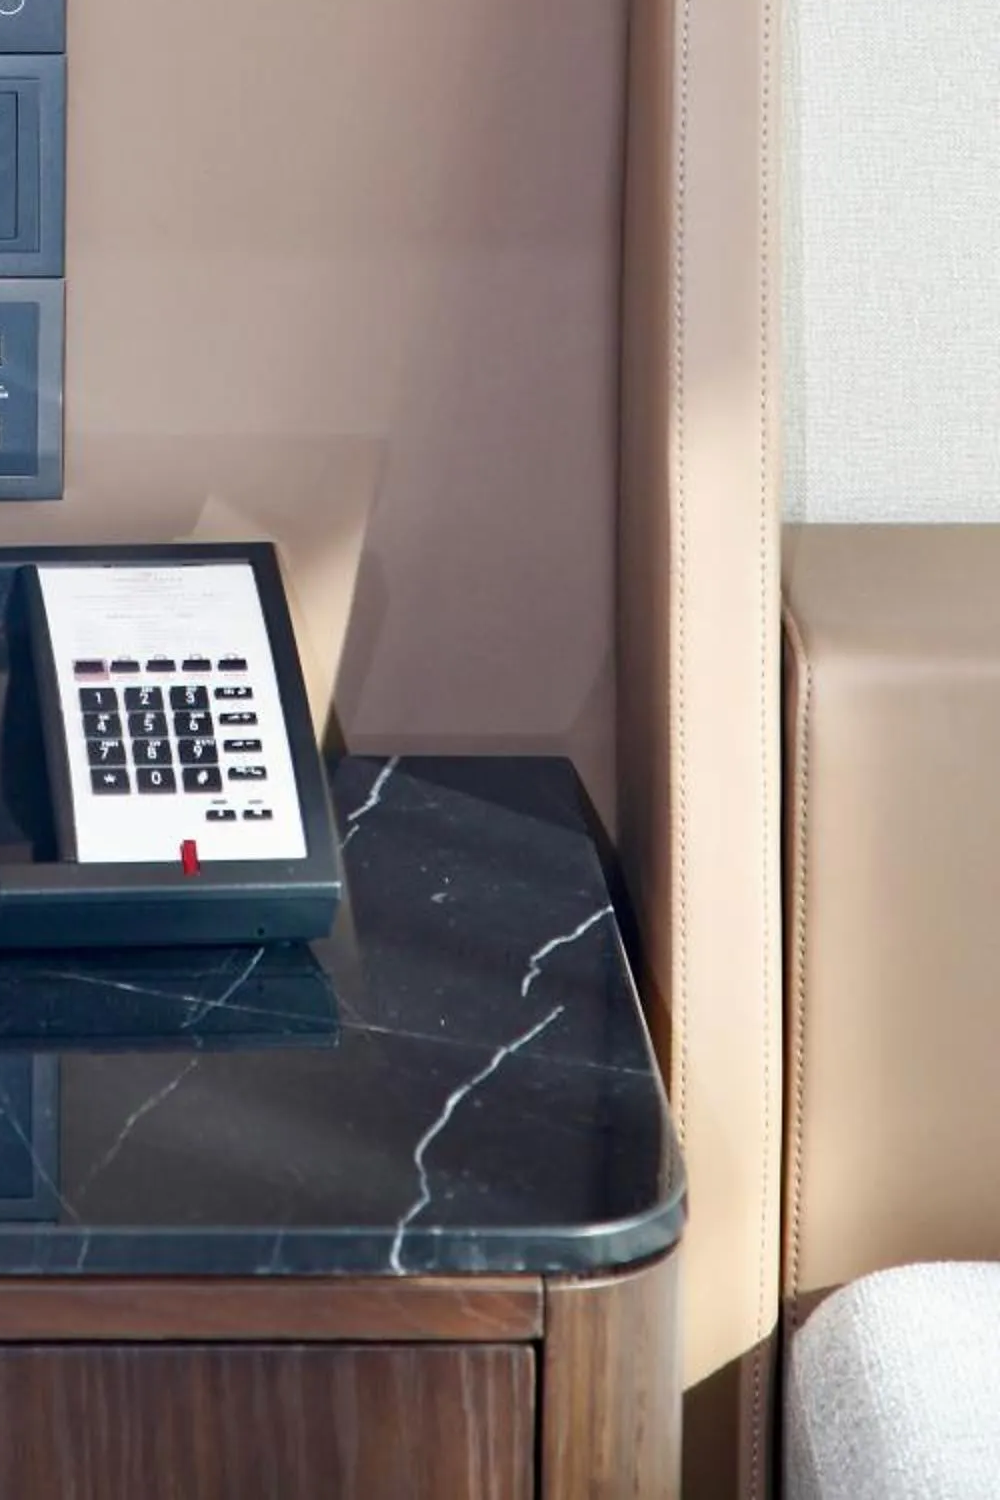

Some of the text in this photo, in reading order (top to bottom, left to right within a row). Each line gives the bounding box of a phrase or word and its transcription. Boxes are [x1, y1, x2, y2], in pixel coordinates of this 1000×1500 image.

[94, 691, 102, 705] 1
[139, 693, 150, 705] 2
[185, 692, 195, 705] 3
[97, 720, 107, 733] 4
[144, 719, 154, 732] 5
[189, 719, 199, 731] 6
[100, 747, 109, 760] 7
[147, 747, 157, 760] 8
[193, 746, 203, 759] 9
[151, 771, 162, 785] 0
